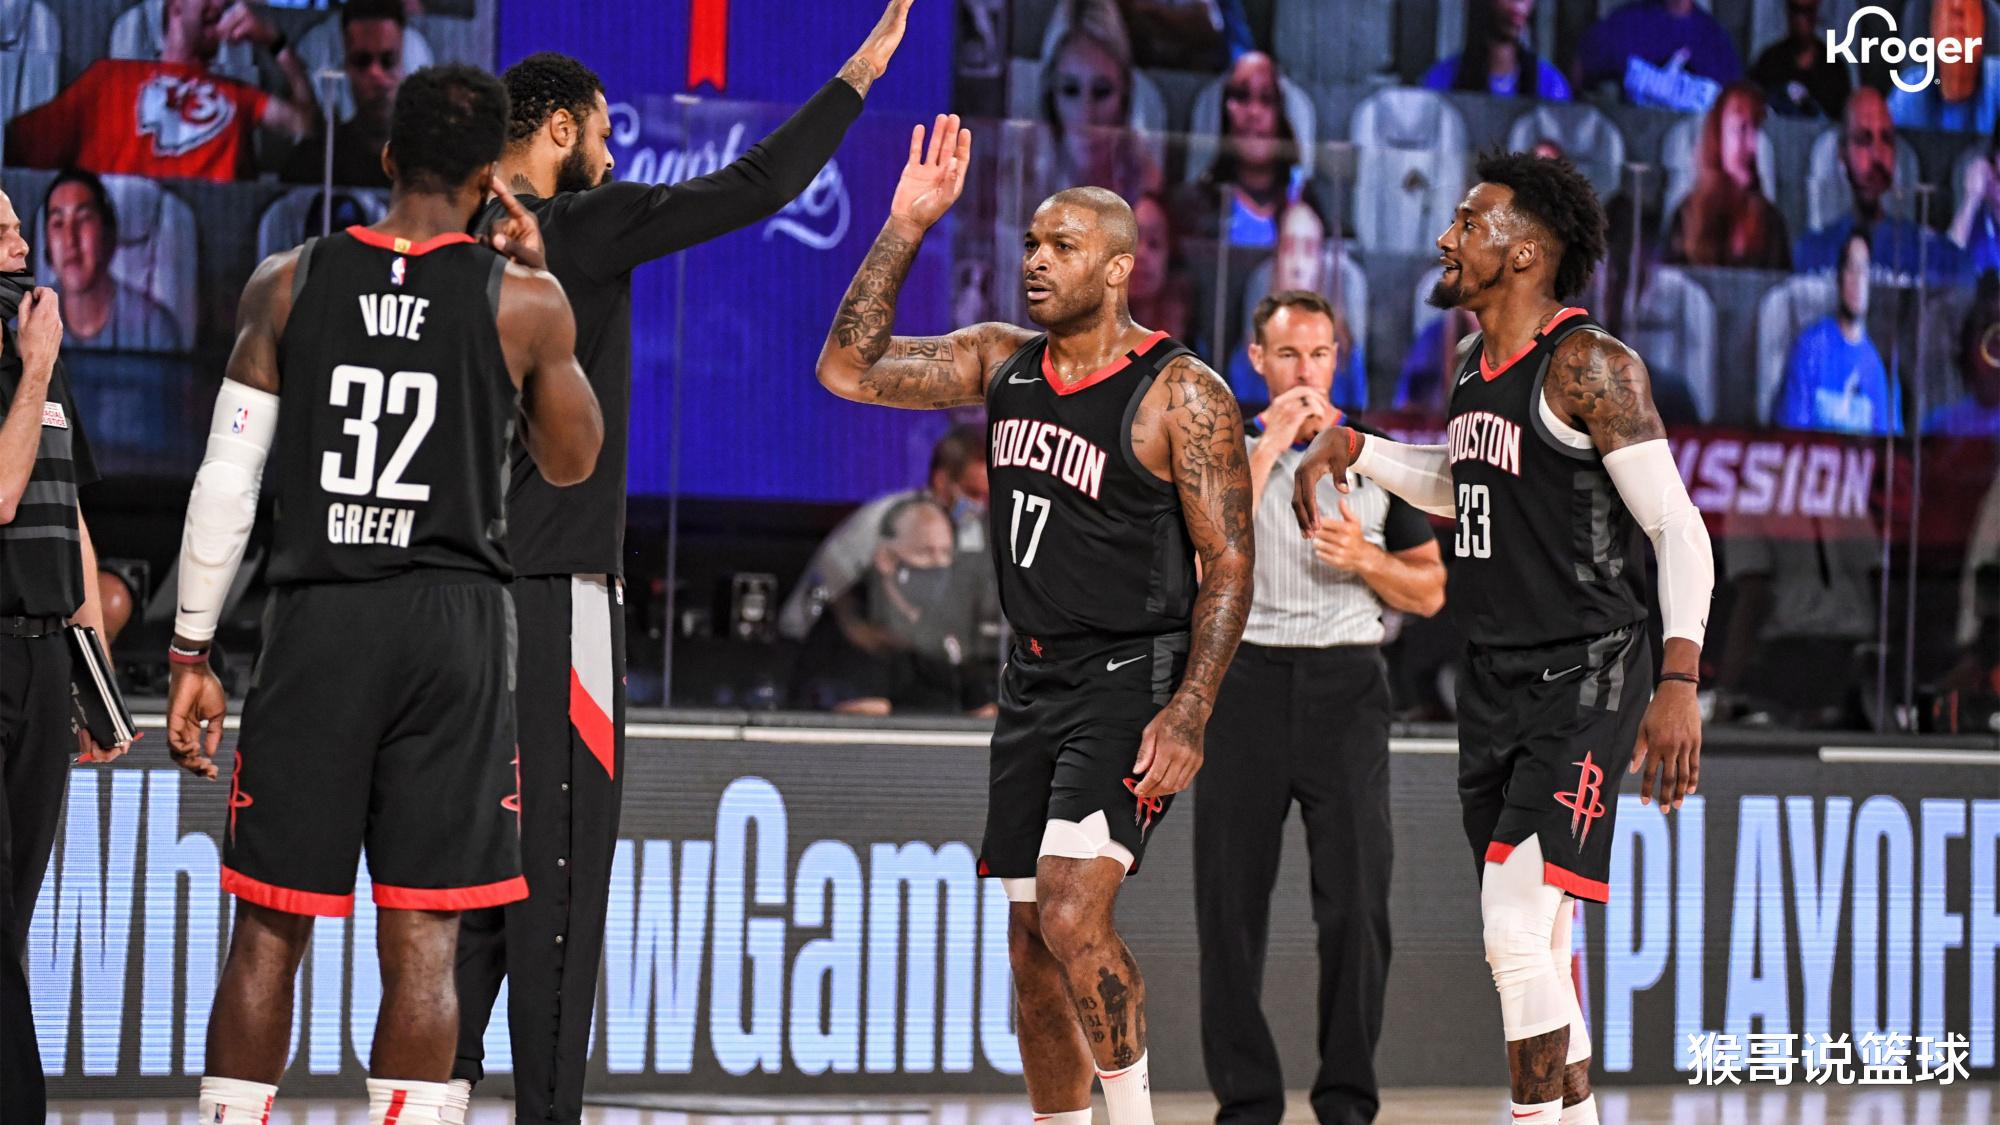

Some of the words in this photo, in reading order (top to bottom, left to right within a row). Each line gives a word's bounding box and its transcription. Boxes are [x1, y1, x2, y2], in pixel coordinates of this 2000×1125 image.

[358, 293, 430, 341] VOTE
[320, 364, 438, 502] 32
[991, 418, 1107, 501] HOUSTON
[327, 502, 415, 548] GREEN
[1010, 489, 1052, 569] 17
[1455, 483, 1491, 559] 33
